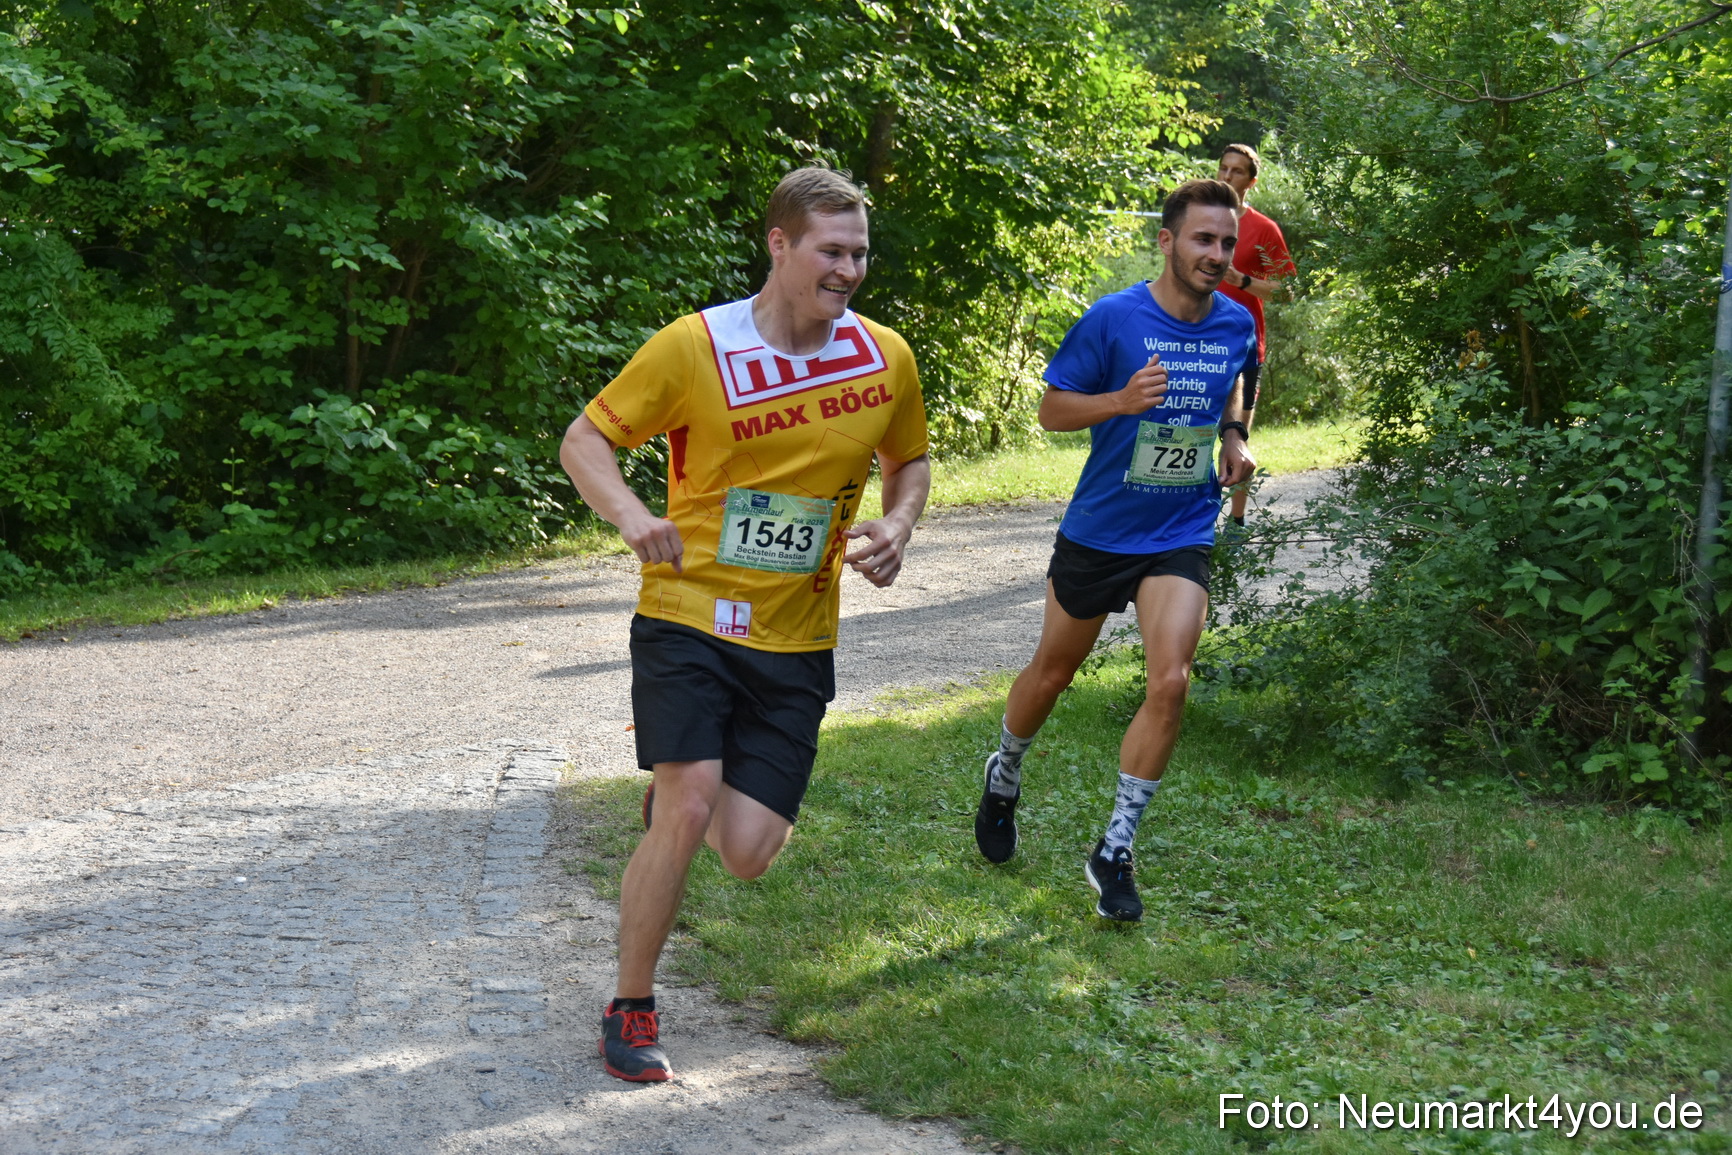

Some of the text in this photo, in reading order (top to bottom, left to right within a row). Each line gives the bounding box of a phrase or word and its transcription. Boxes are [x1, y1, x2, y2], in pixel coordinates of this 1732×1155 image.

[1144, 337, 1229, 356] Wenn es beim
[1148, 357, 1227, 374] ausverkauf
[1167, 377, 1207, 393] richtig
[731, 383, 893, 442] MAX BÖGL
[1168, 415, 1191, 427] soll!
[1153, 446, 1198, 470] 728
[1150, 467, 1194, 476] Meier Andreas
[737, 517, 814, 552] 1543
[736, 545, 807, 560] Beckstein Bastian
